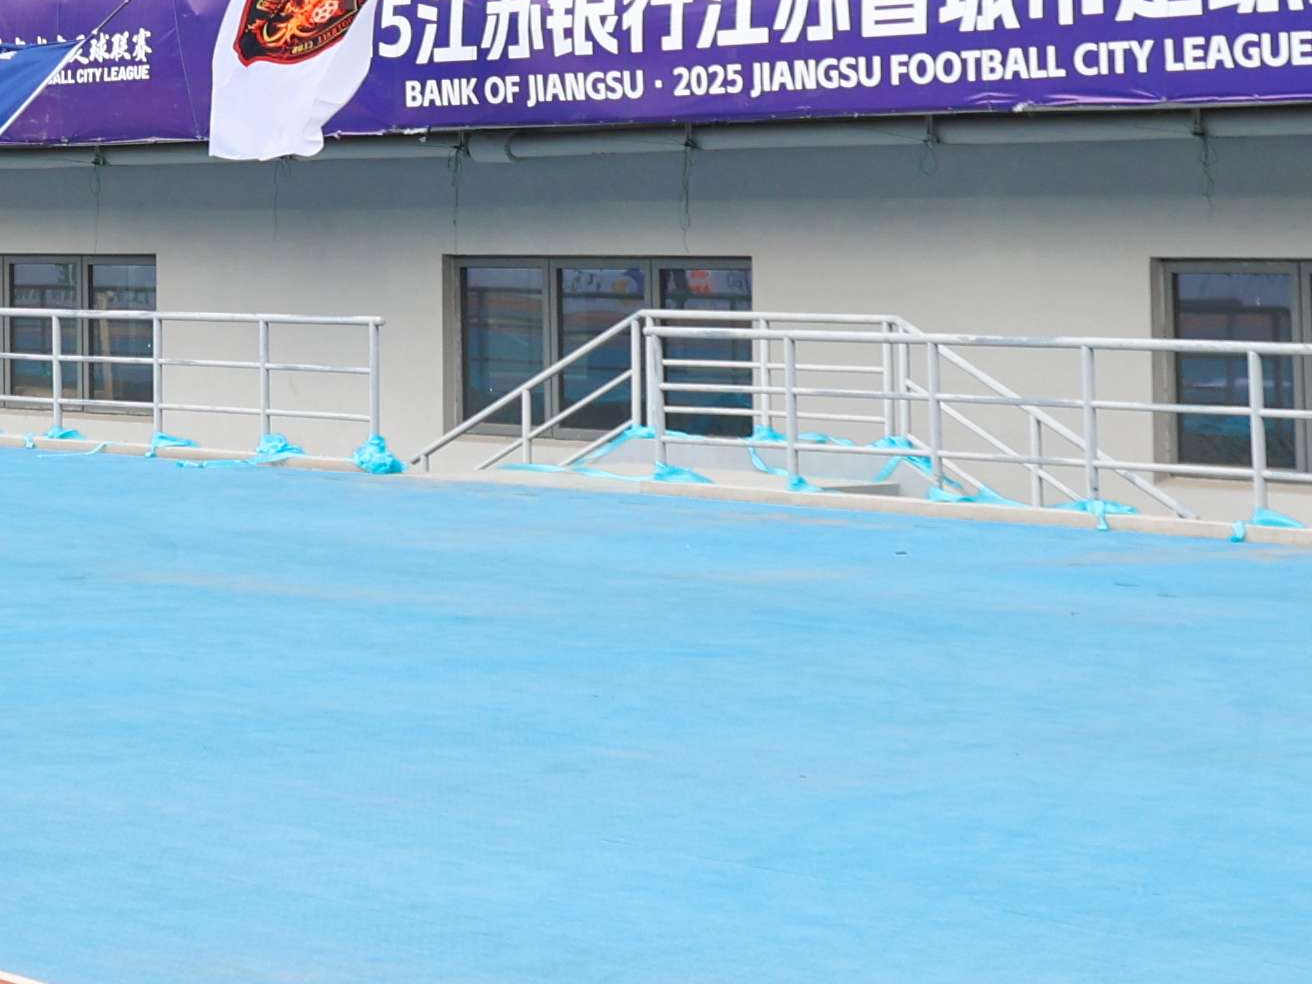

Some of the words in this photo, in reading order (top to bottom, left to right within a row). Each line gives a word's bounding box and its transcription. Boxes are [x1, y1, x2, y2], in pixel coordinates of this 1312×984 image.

[77, 67, 103, 83] CITY
[103, 64, 150, 82] LEAGUE
[405, 78, 480, 108] BANK
[484, 76, 520, 104] OF
[527, 69, 644, 107] JIANGSU
[673, 63, 744, 97] 2025
[750, 56, 882, 98] JIANGSU
[890, 45, 1067, 86] FOOTBALL
[1073, 39, 1155, 76] CITY
[1164, 31, 1312, 72] LEAGUE
